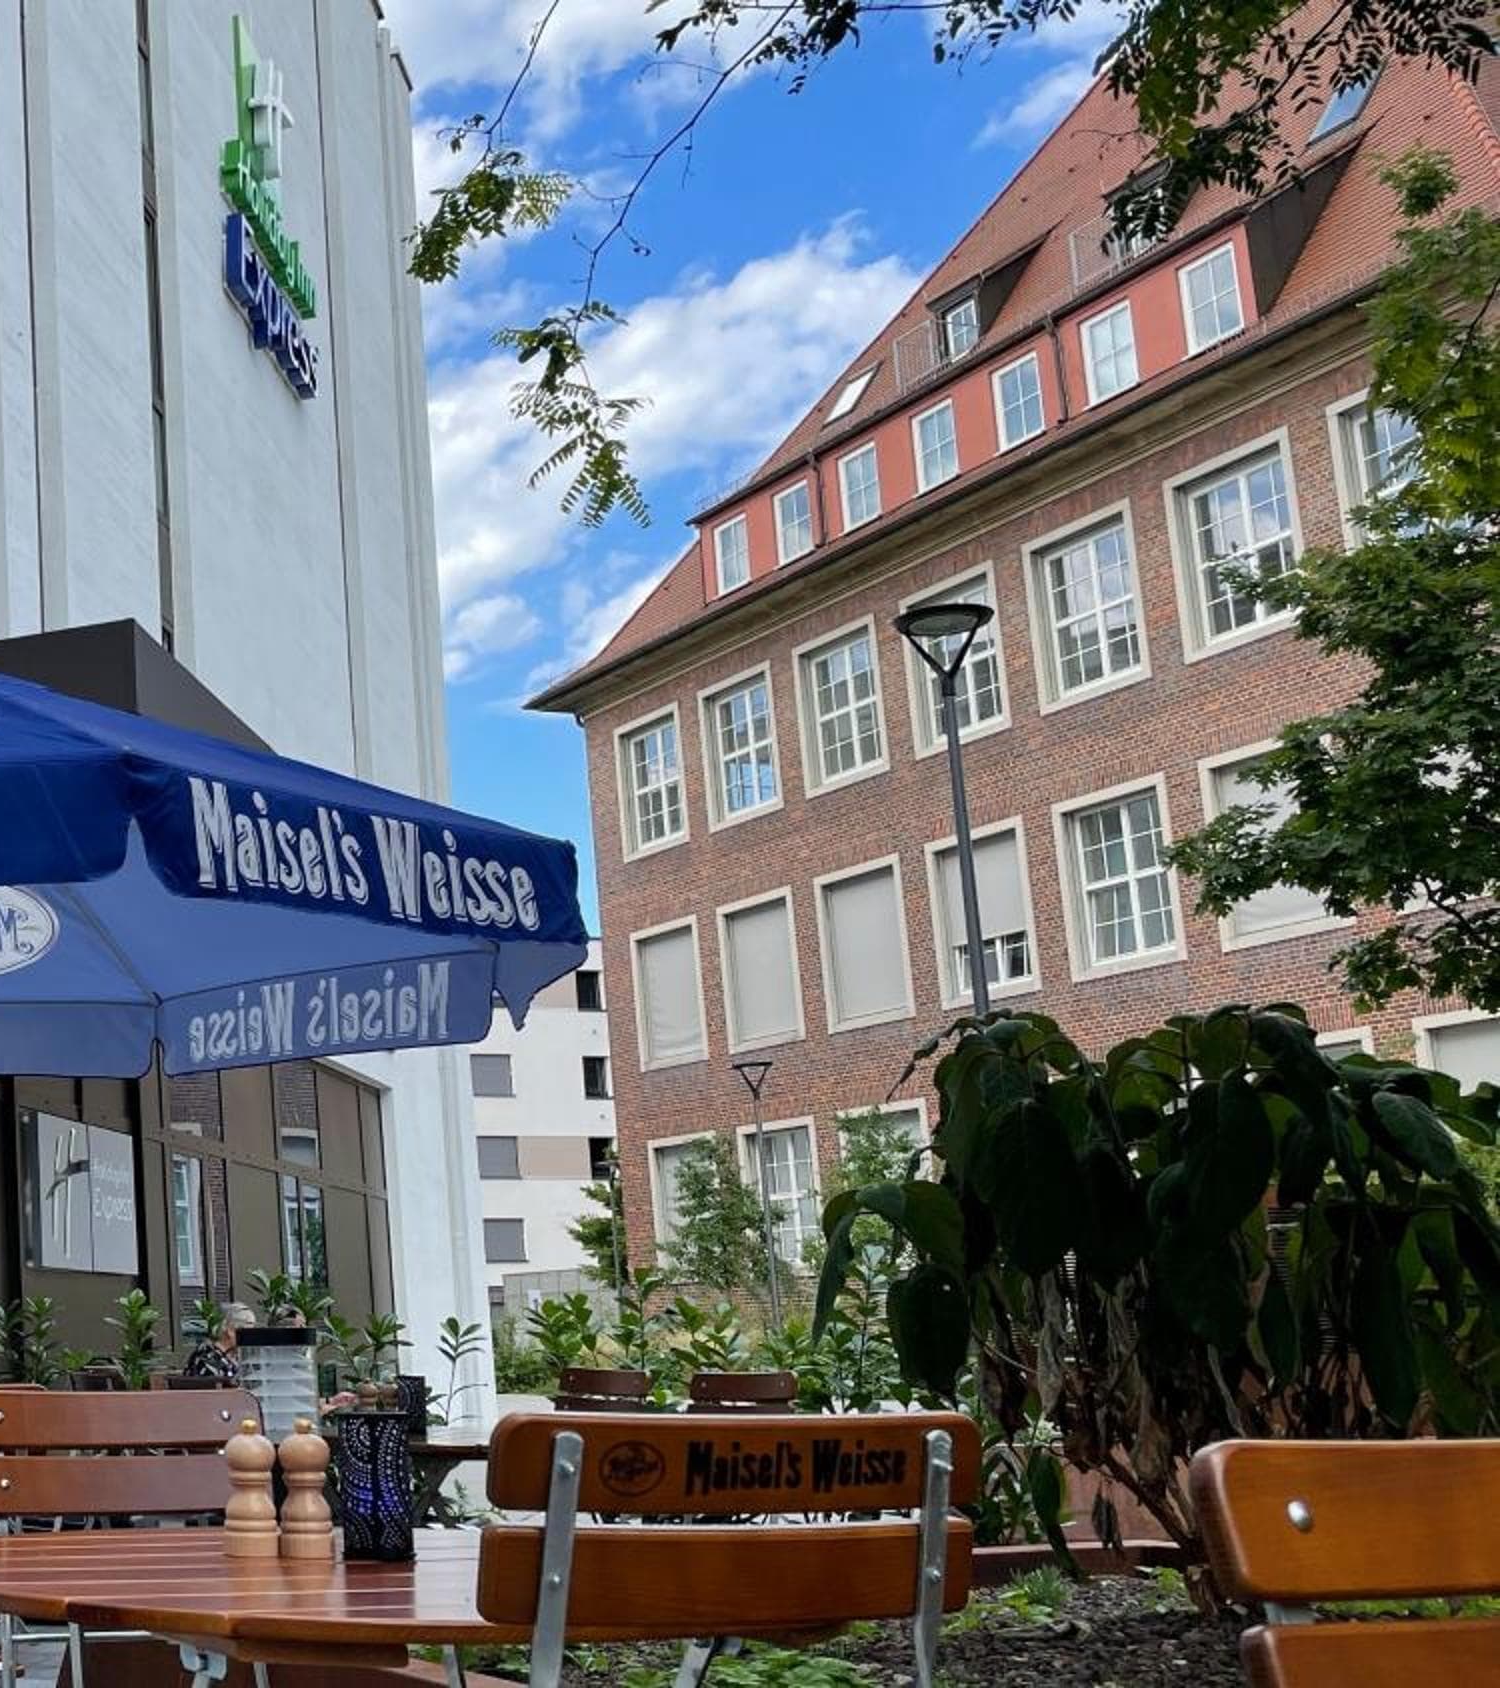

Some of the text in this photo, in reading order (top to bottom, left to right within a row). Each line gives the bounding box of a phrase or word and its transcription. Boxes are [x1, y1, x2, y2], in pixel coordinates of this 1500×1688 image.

[188, 776, 541, 932] Maisel's Weisse
[684, 1441, 801, 1496] Maisel's
[812, 1438, 907, 1493] Weisse
